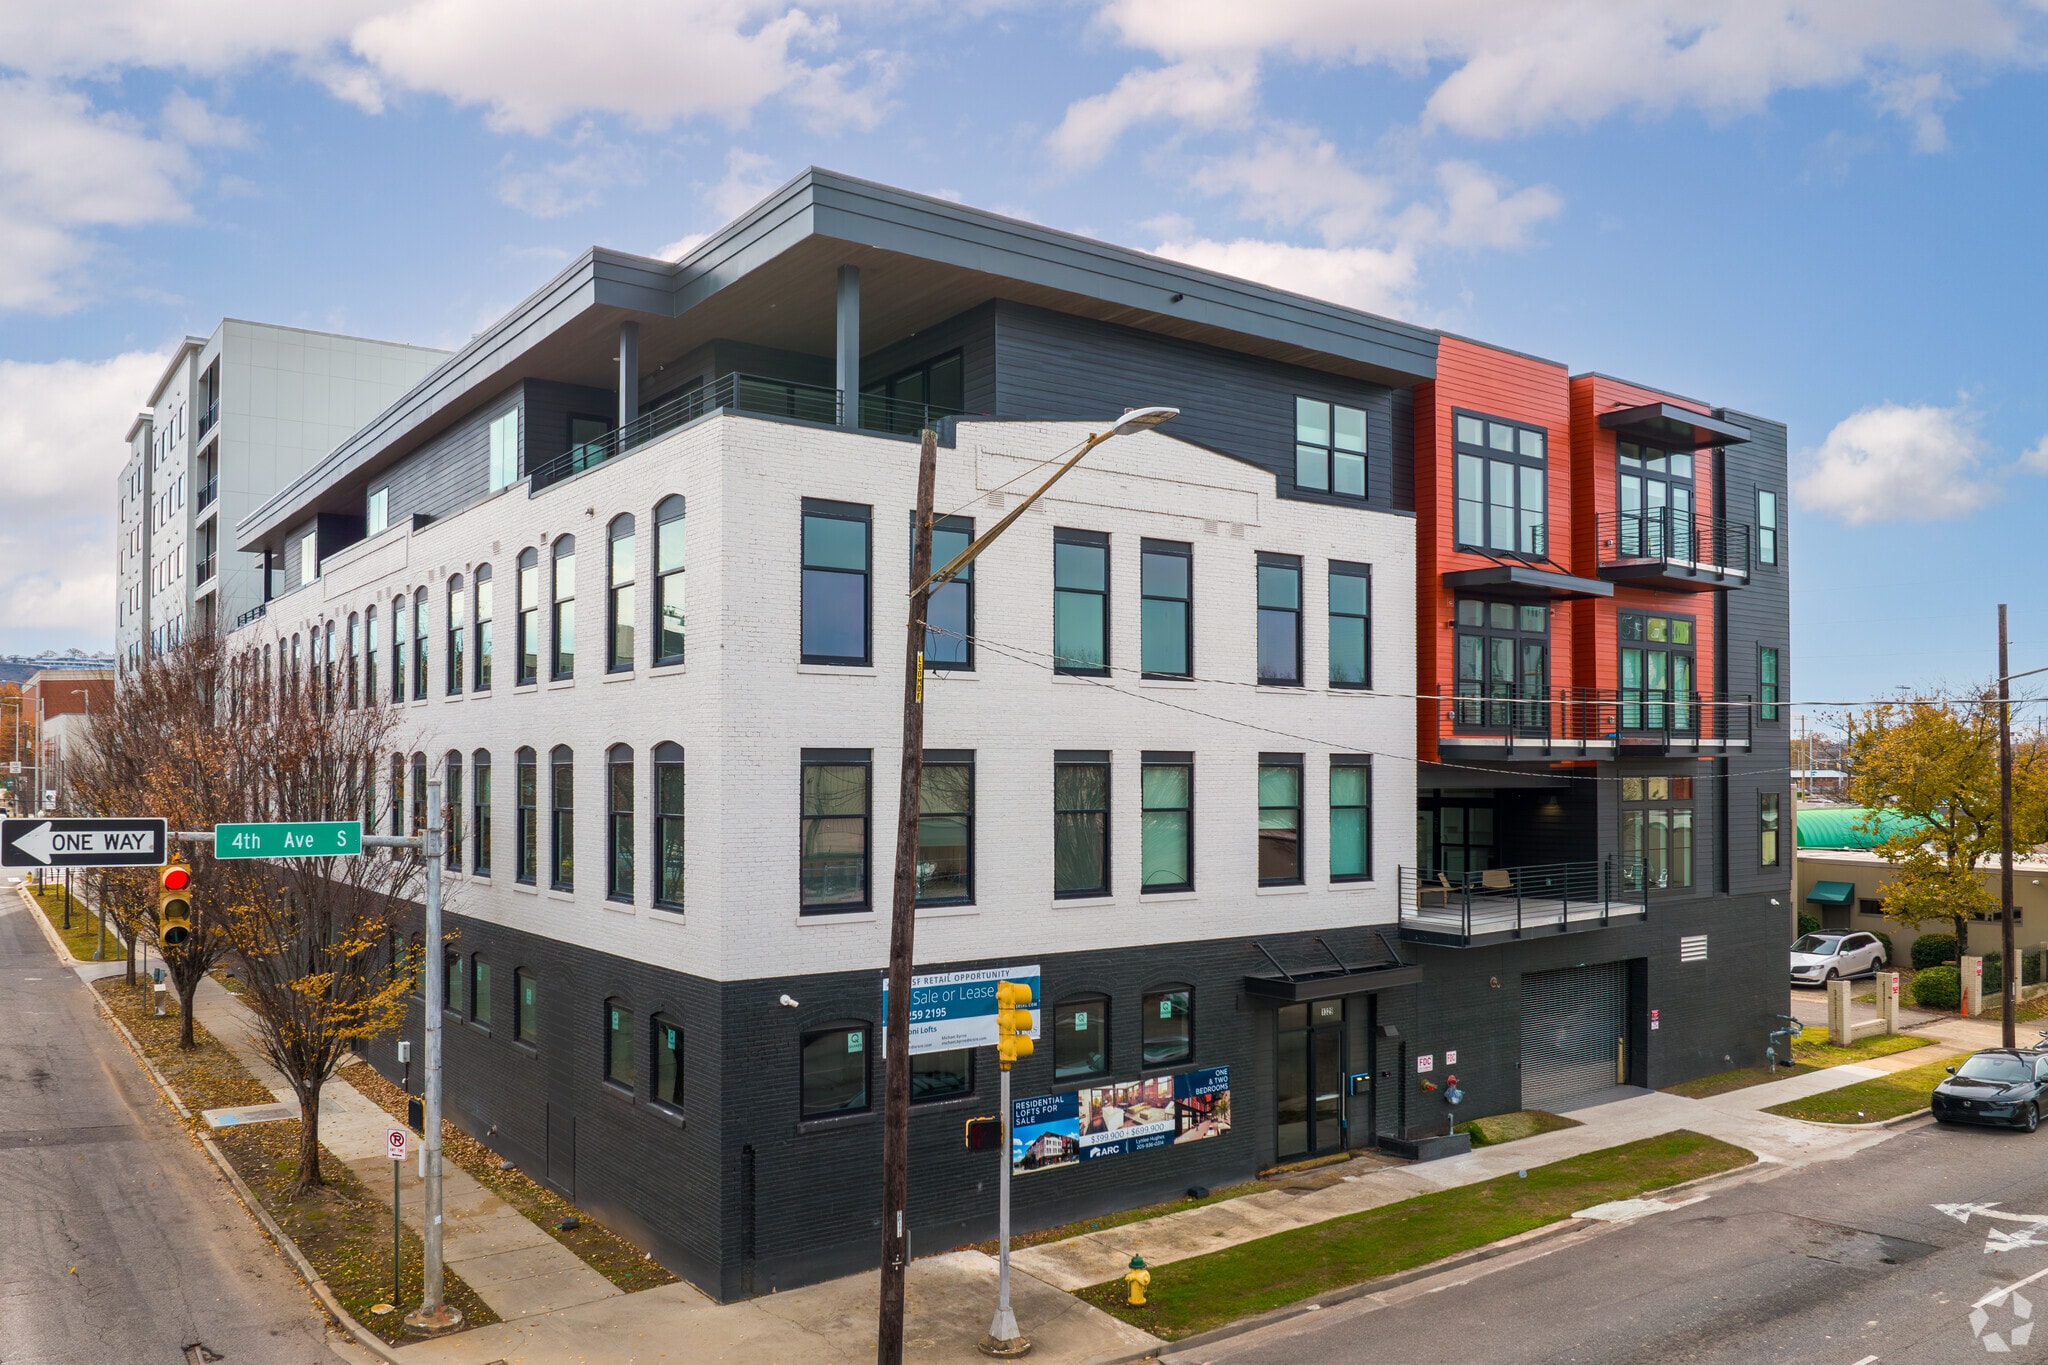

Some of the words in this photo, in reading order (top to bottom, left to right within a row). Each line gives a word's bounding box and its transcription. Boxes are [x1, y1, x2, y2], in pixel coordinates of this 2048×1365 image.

[52, 833, 93, 851] ONE
[104, 833, 146, 850] WAY
[231, 832, 261, 849] 4th
[284, 831, 314, 848] Ave
[337, 830, 347, 847] S
[912, 978, 921, 986] SF
[924, 975, 952, 985] RETAIL
[954, 970, 1010, 982] OPPORTUNITY
[912, 989, 939, 1005] Sale
[942, 990, 956, 1002] or
[960, 986, 995, 1000] Lease
[925, 1007, 947, 1019] 2195
[920, 1025, 938, 1034] Lofts
[1420, 1057, 1431, 1066] FDC
[1215, 1068, 1228, 1077] ONE
[1214, 1075, 1228, 1084] TWO
[1195, 1082, 1229, 1095] BEDROOMS
[1015, 1096, 1065, 1110] RESIDENTIAL
[1015, 1107, 1040, 1118] LOFTS
[1042, 1104, 1058, 1114] FOR
[1015, 1116, 1036, 1126] SALE
[1090, 1130, 1125, 1144] $399,900
[1130, 1123, 1165, 1136] $699,900
[1101, 1145, 1120, 1156] ARC
